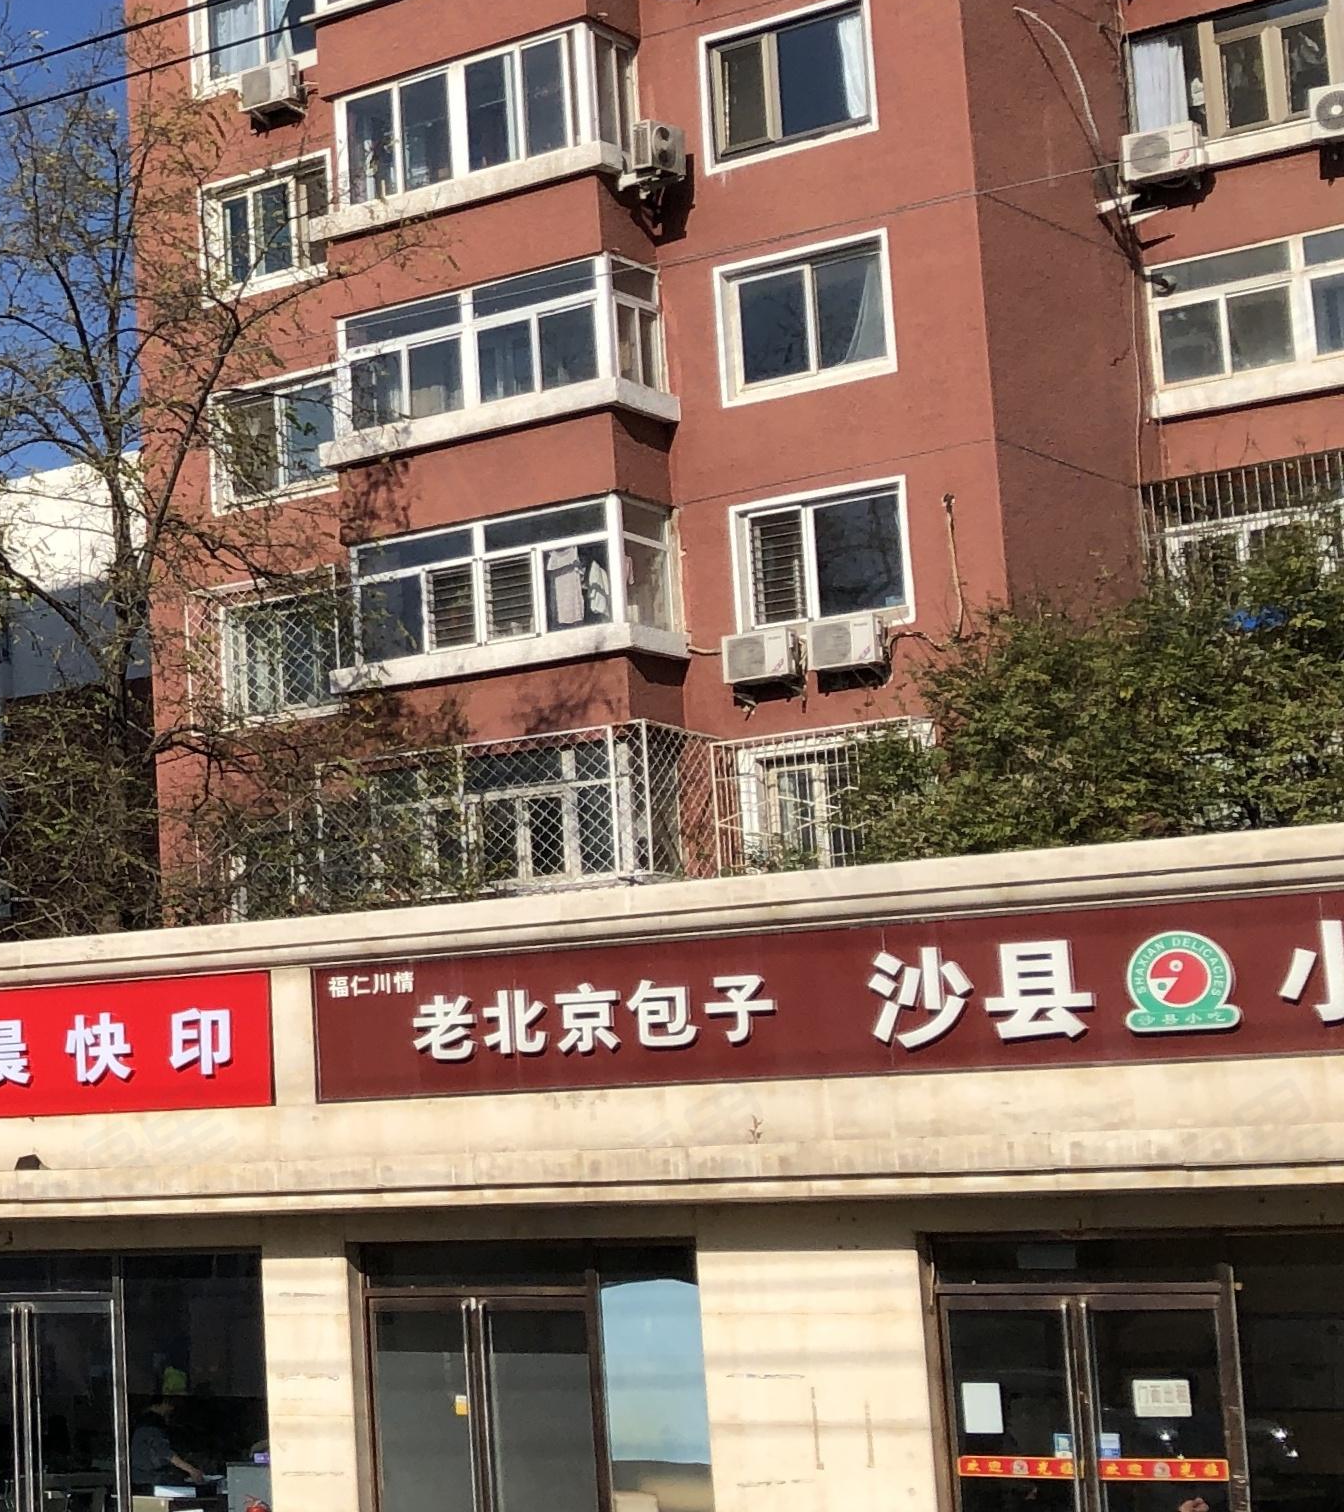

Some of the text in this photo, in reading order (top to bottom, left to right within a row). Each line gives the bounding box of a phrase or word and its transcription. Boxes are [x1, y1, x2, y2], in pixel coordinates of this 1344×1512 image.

[328, 971, 415, 998] 福仁川情
[868, 940, 1096, 1051] 沙县
[1134, 937, 1224, 996] SHAXIAN DELICACIES
[413, 975, 778, 1061] 老北京包子
